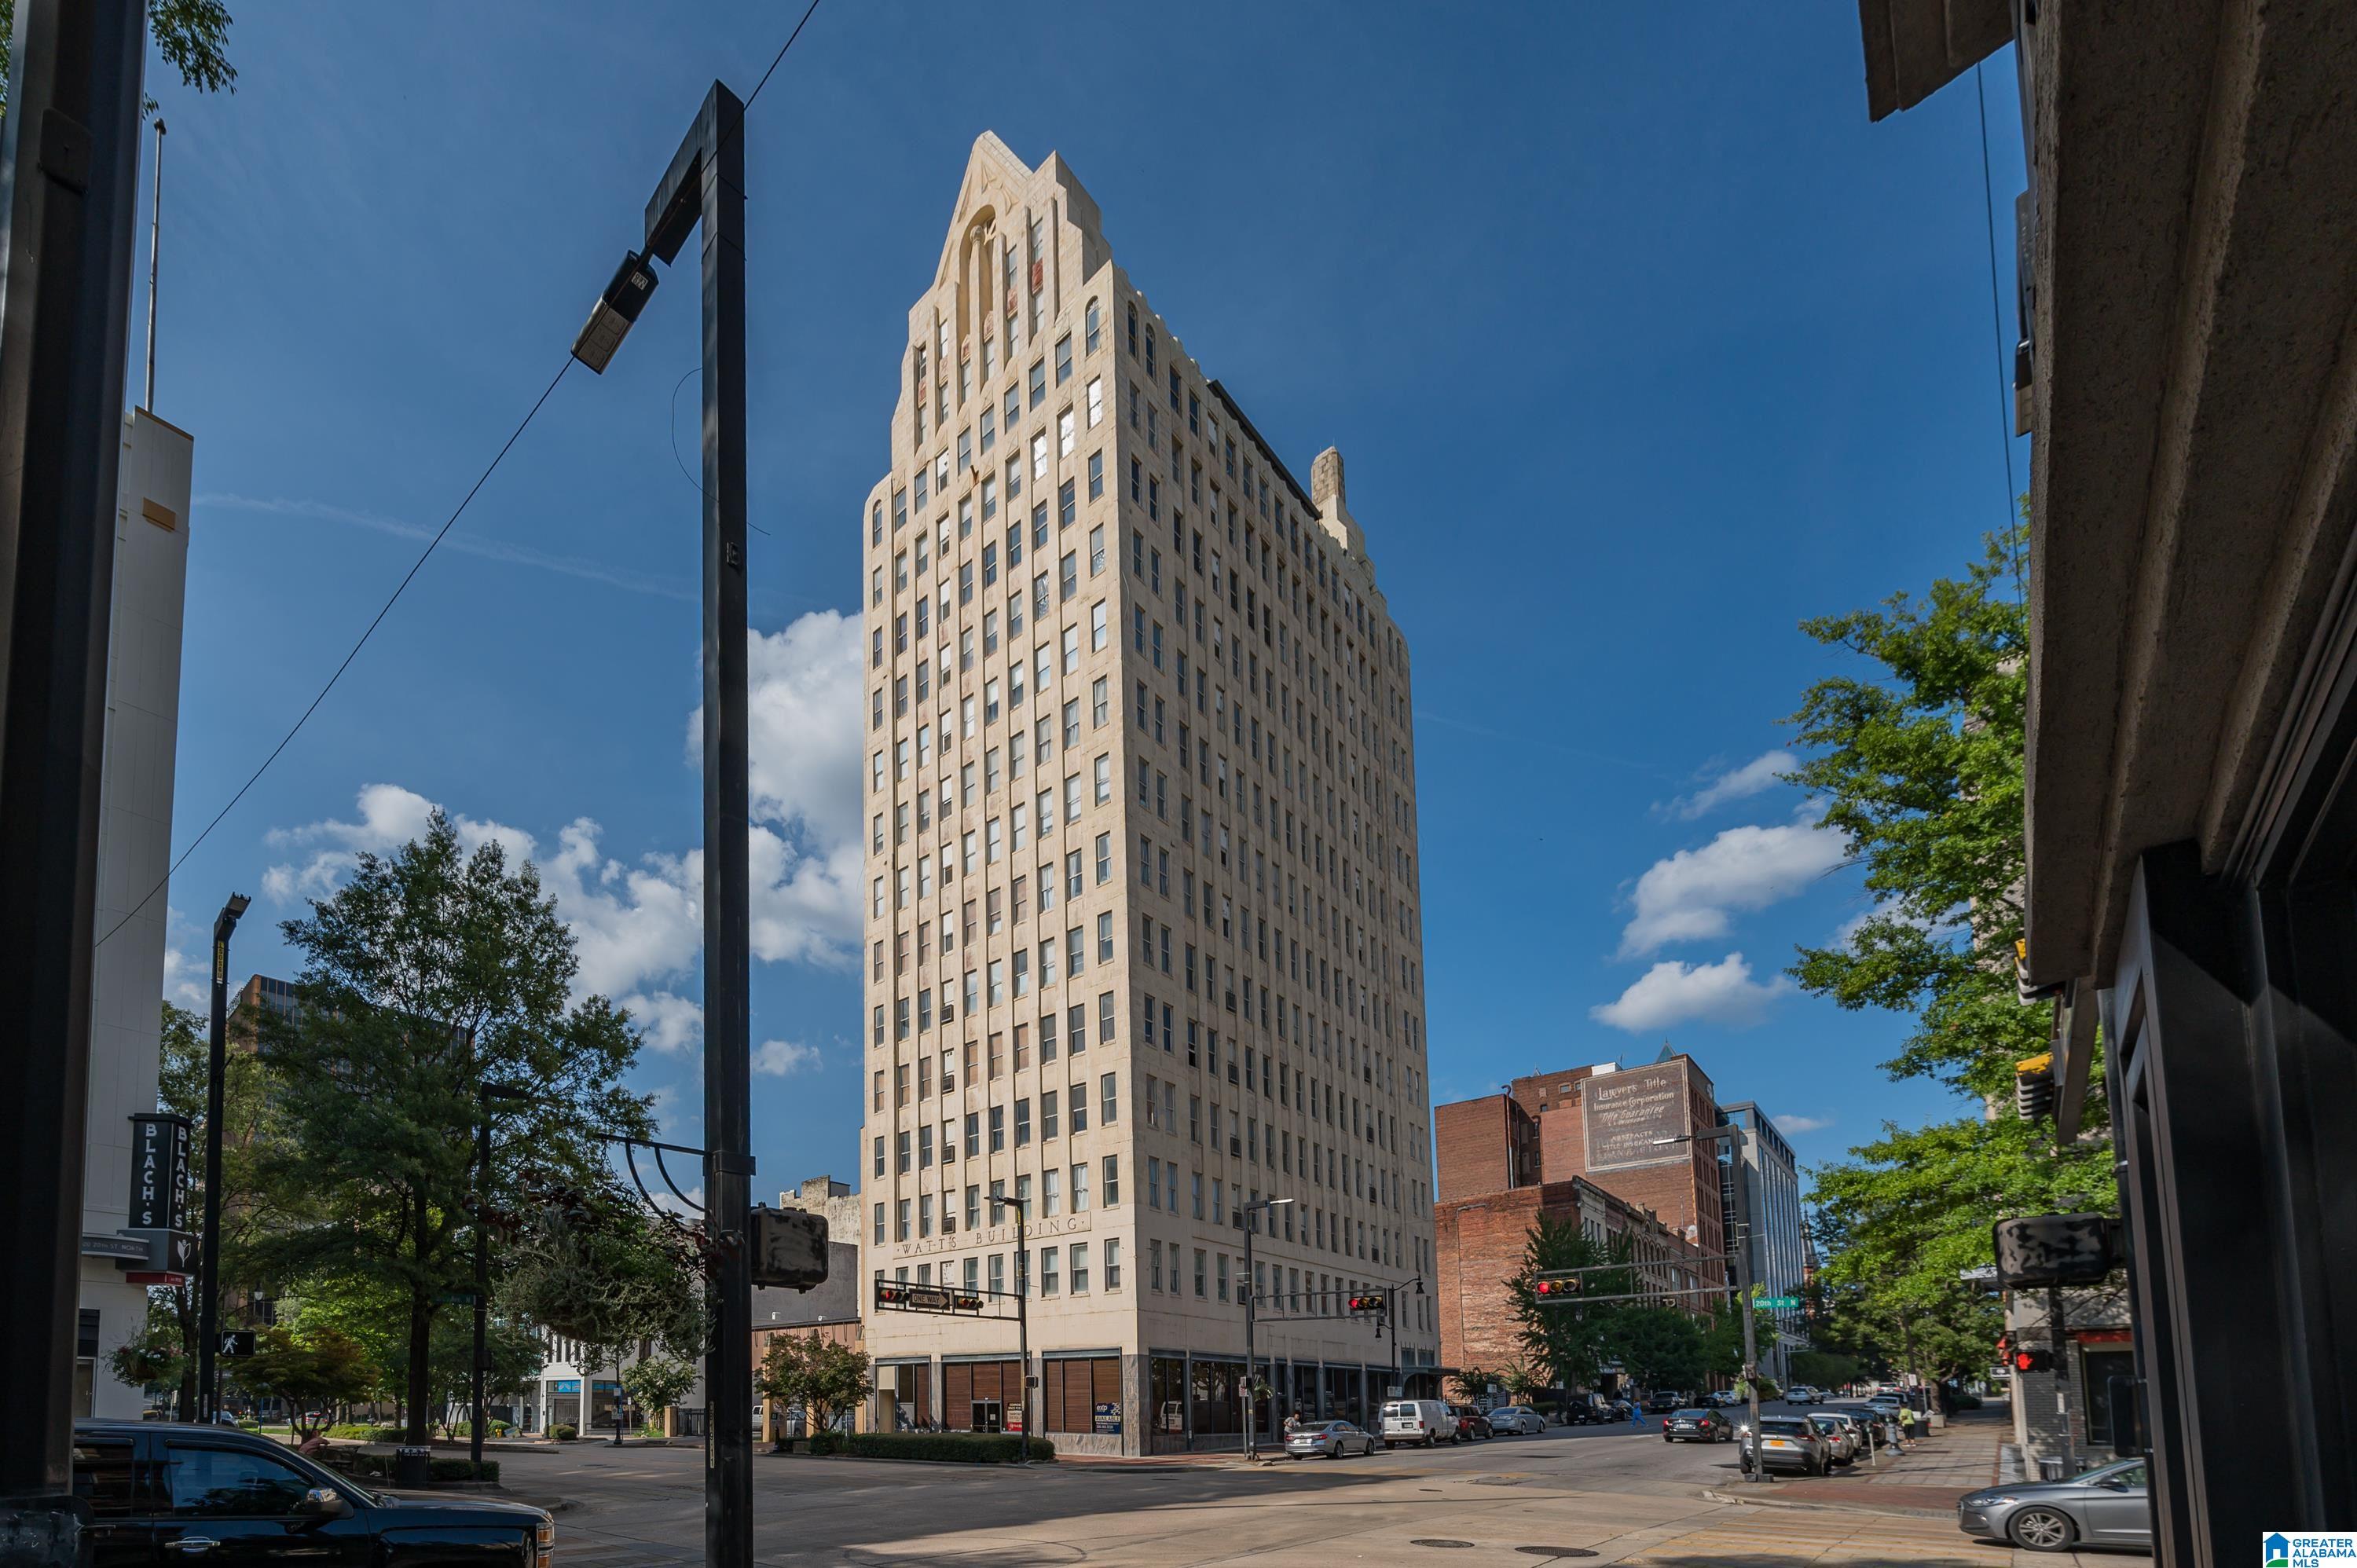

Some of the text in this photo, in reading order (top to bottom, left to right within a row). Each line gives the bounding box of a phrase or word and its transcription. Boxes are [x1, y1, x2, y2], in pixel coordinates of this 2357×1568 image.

[1594, 1092, 1674, 1111] Insurance Corporation
[1598, 1077, 1666, 1100] Lawyers Title
[142, 1123, 157, 1225] BLACH'S
[174, 1126, 187, 1228] BLACH'S
[976, 1218, 1076, 1244] BUILDING
